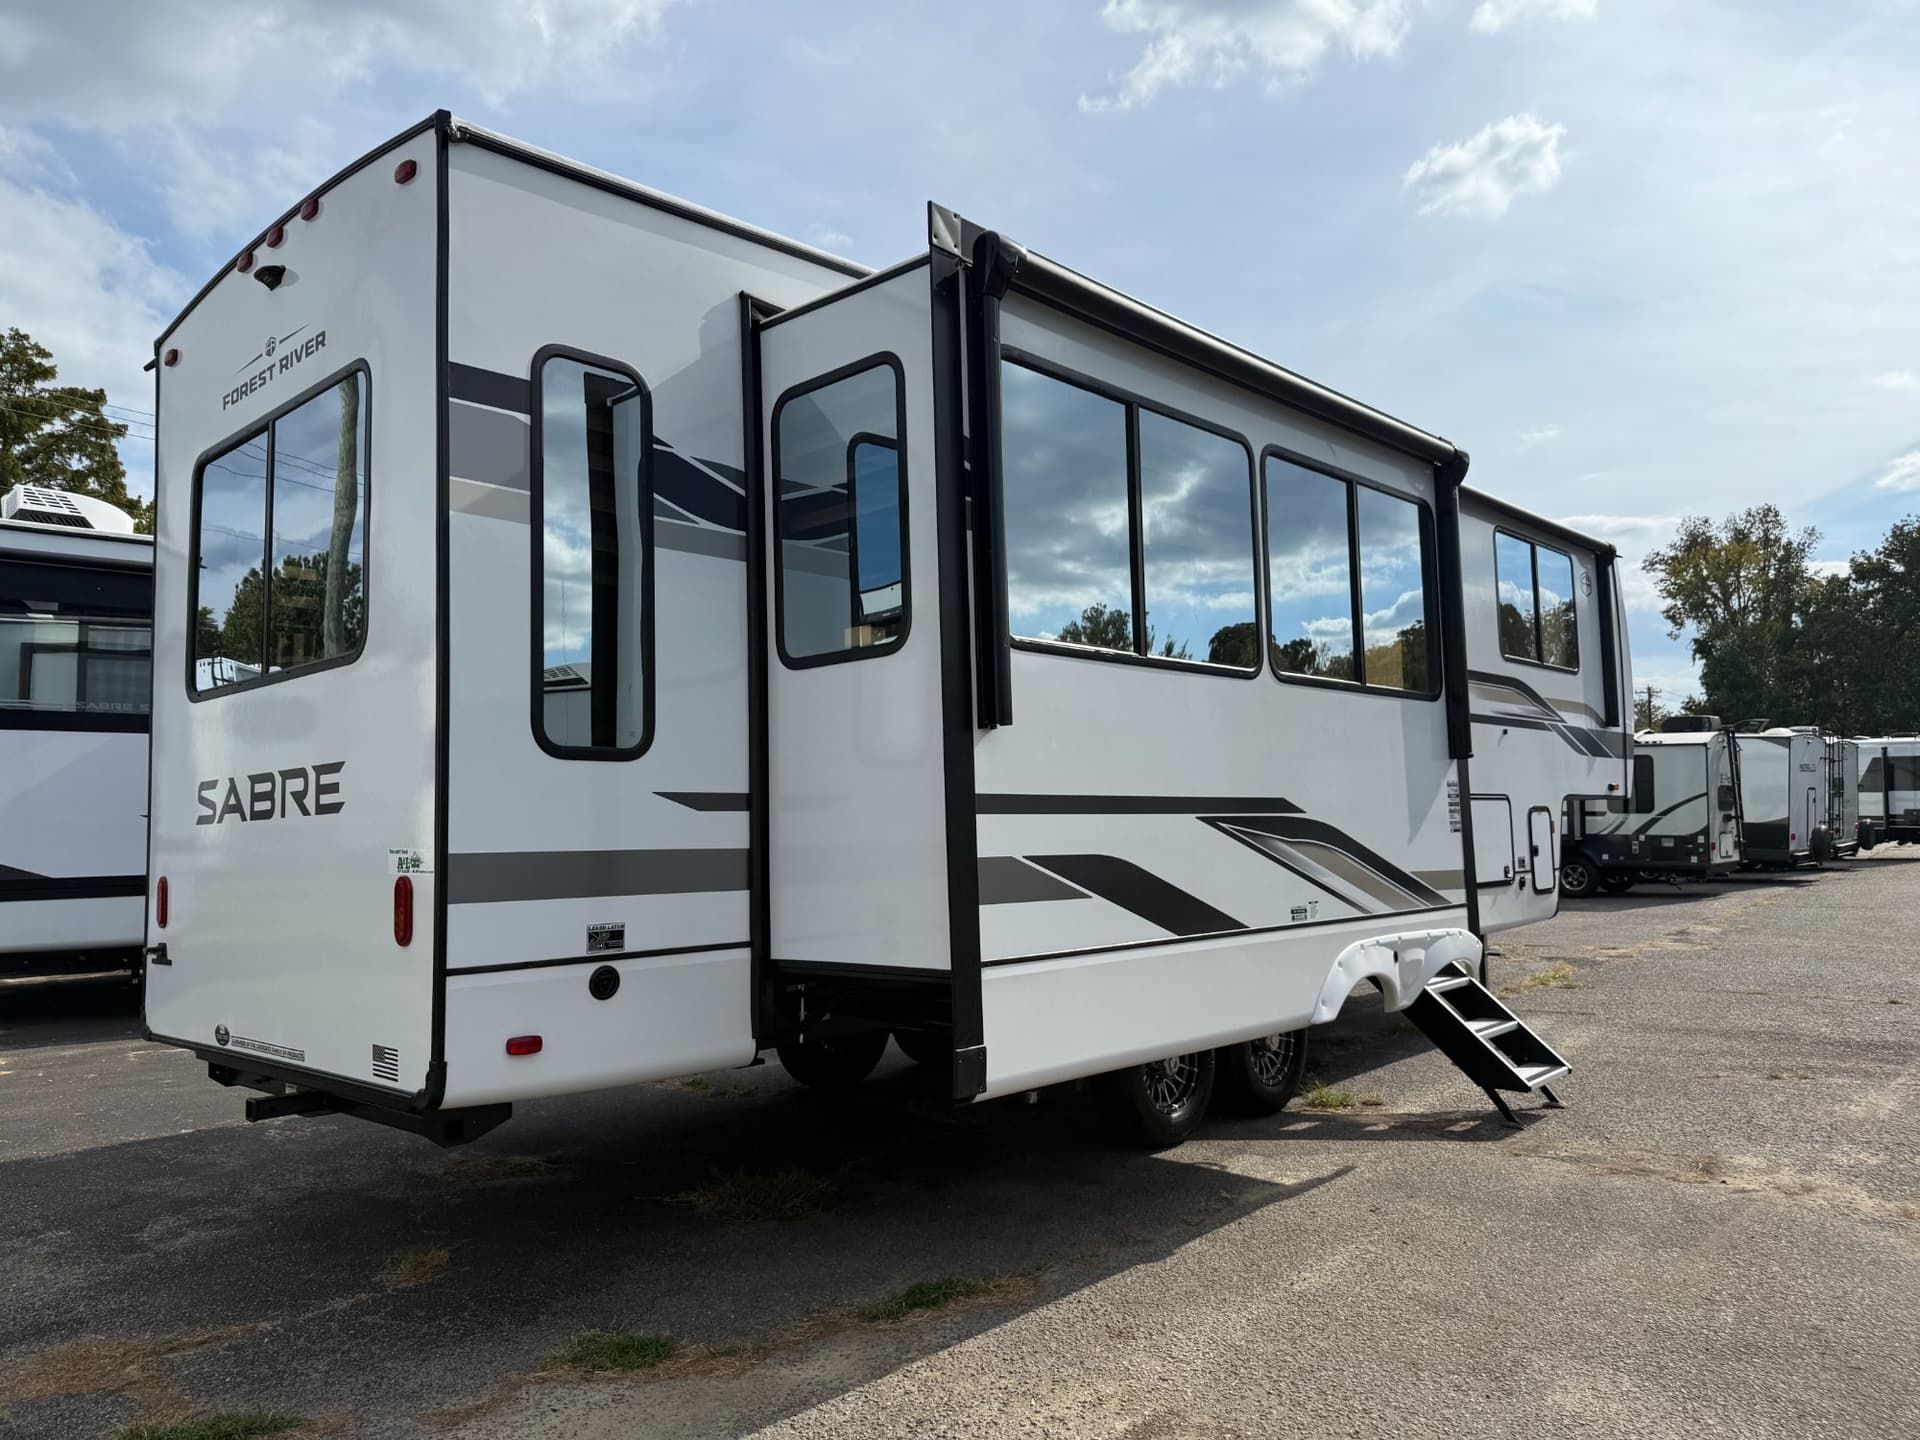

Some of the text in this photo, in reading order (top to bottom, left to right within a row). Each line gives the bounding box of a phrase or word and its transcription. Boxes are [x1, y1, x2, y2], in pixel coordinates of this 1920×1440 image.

[222, 330, 327, 412] FOREST RIVER
[196, 761, 346, 826] SABRE
